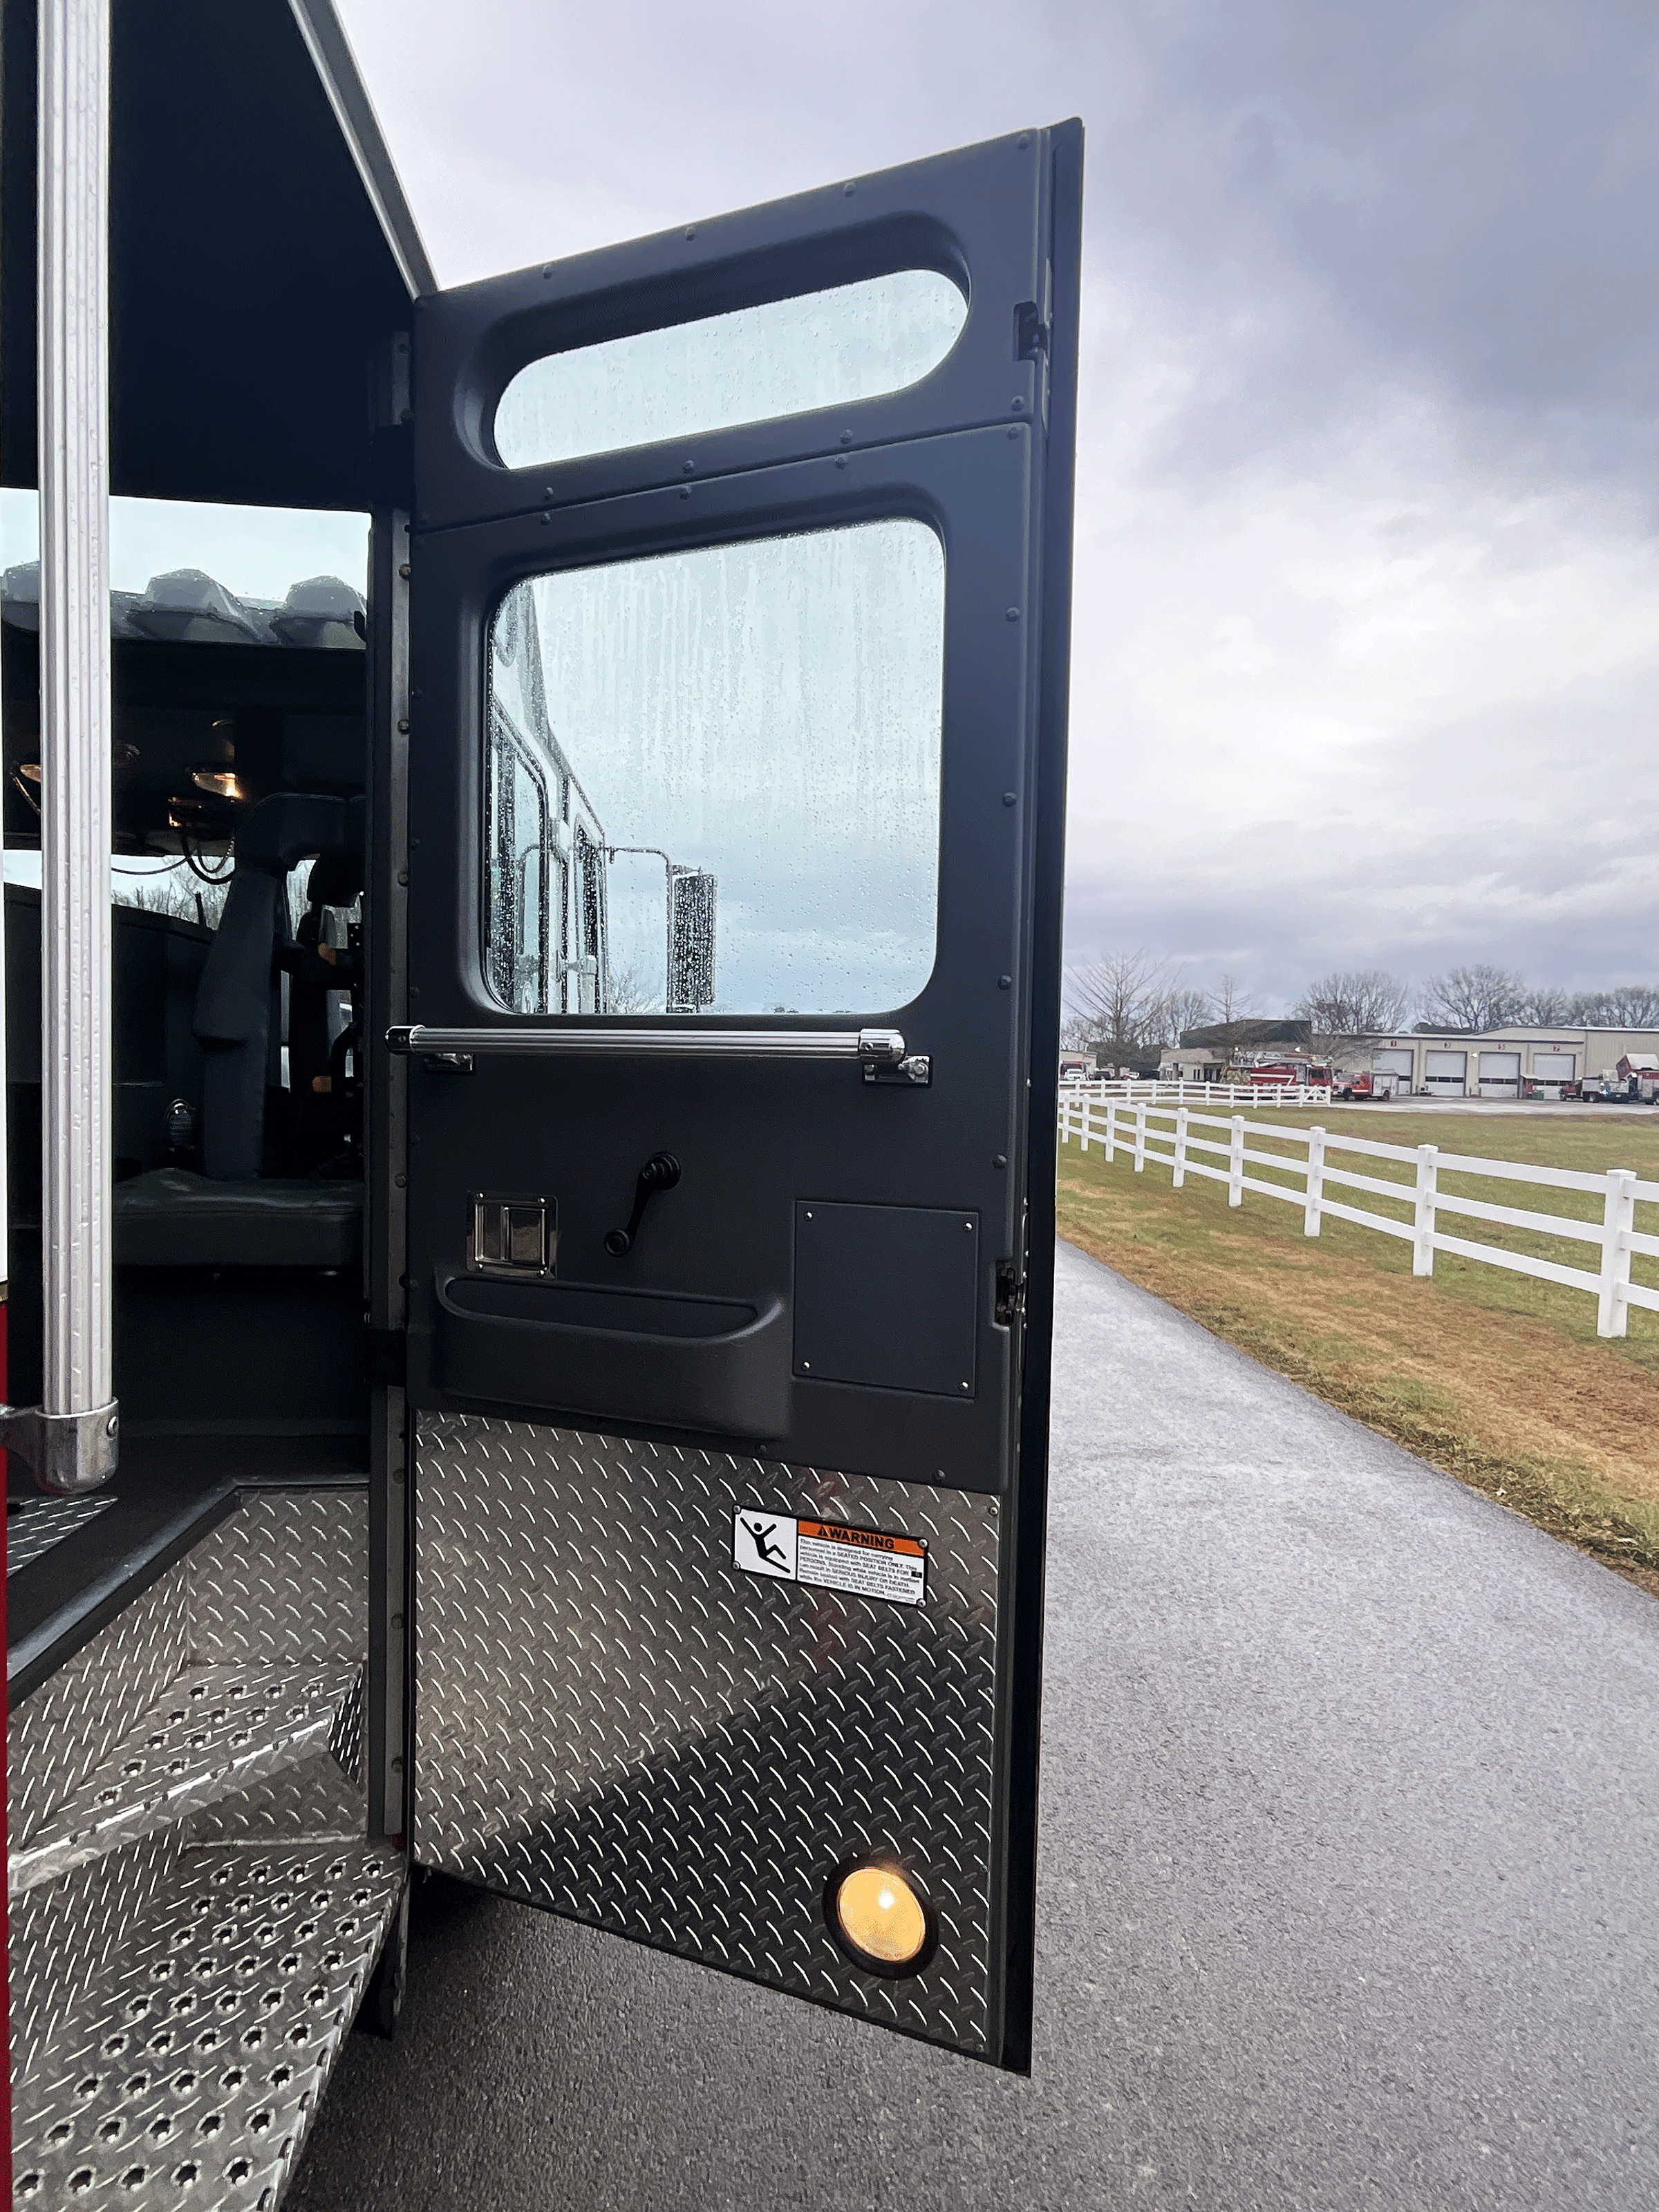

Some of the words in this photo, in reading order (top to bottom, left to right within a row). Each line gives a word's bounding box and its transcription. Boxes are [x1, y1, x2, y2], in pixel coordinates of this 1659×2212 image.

[829, 1528, 894, 1549] WARNING
[837, 1551, 858, 1559] SEATED
[860, 1556, 885, 1564] POSITION
[885, 1584, 915, 1594] FASTENED
